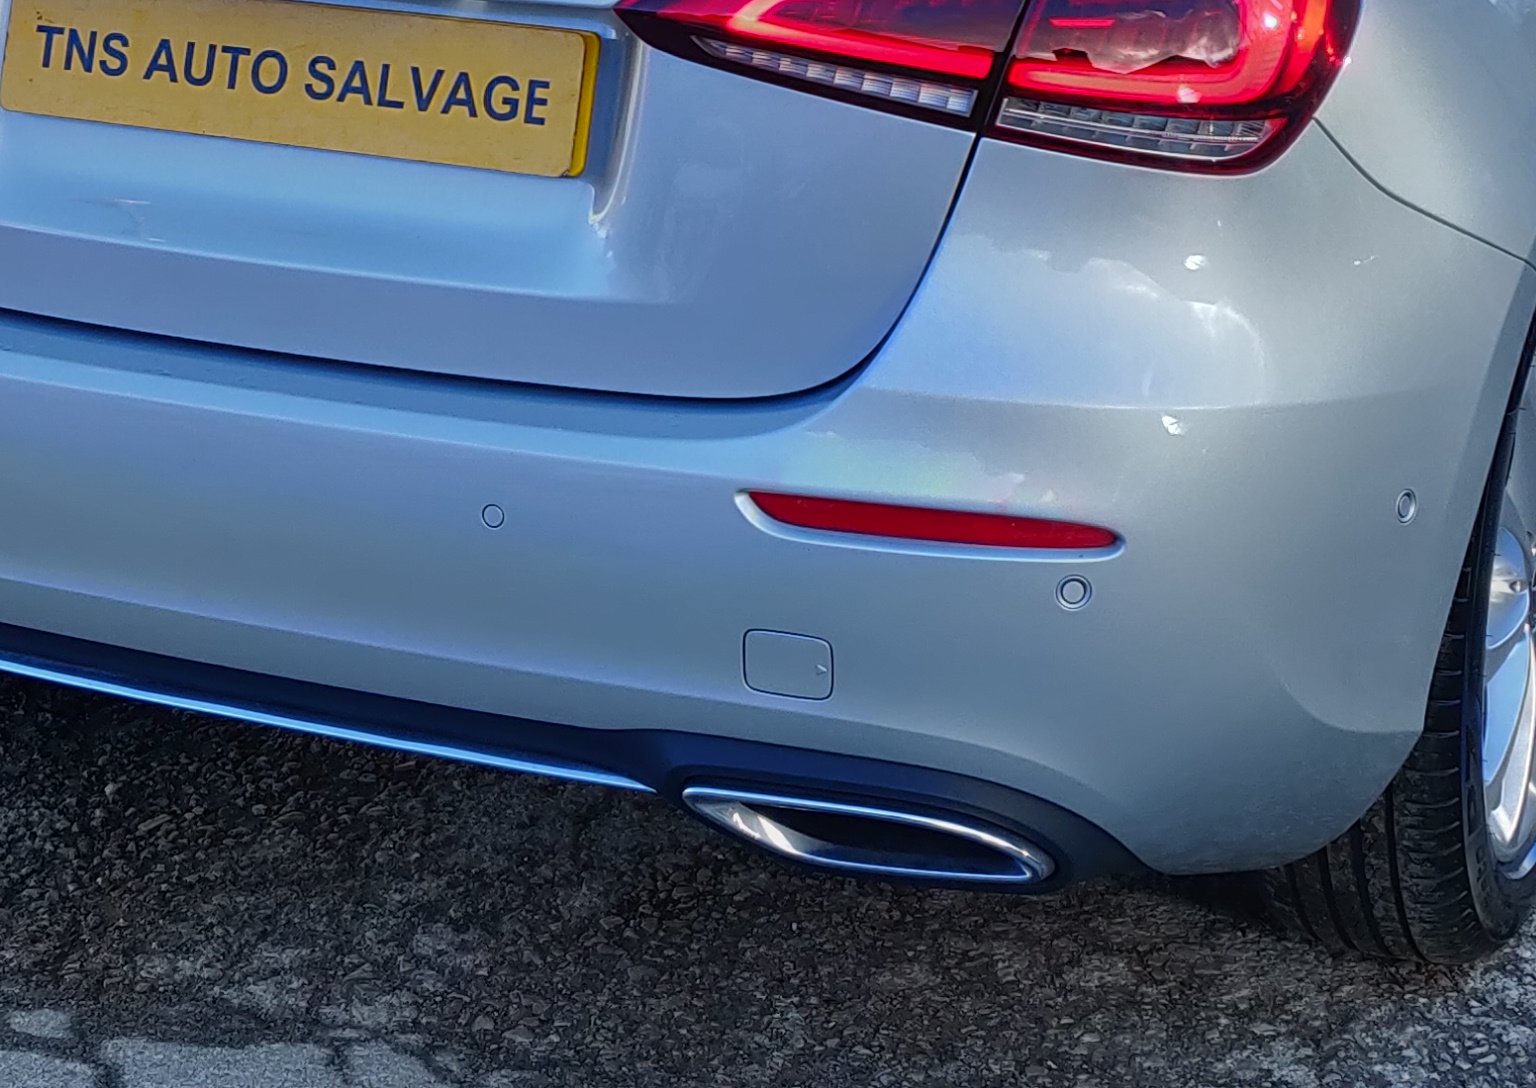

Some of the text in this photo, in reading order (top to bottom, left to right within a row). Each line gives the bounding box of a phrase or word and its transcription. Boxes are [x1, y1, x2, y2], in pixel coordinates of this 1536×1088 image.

[35, 24, 551, 127] TNS AUTO SALVAGE
